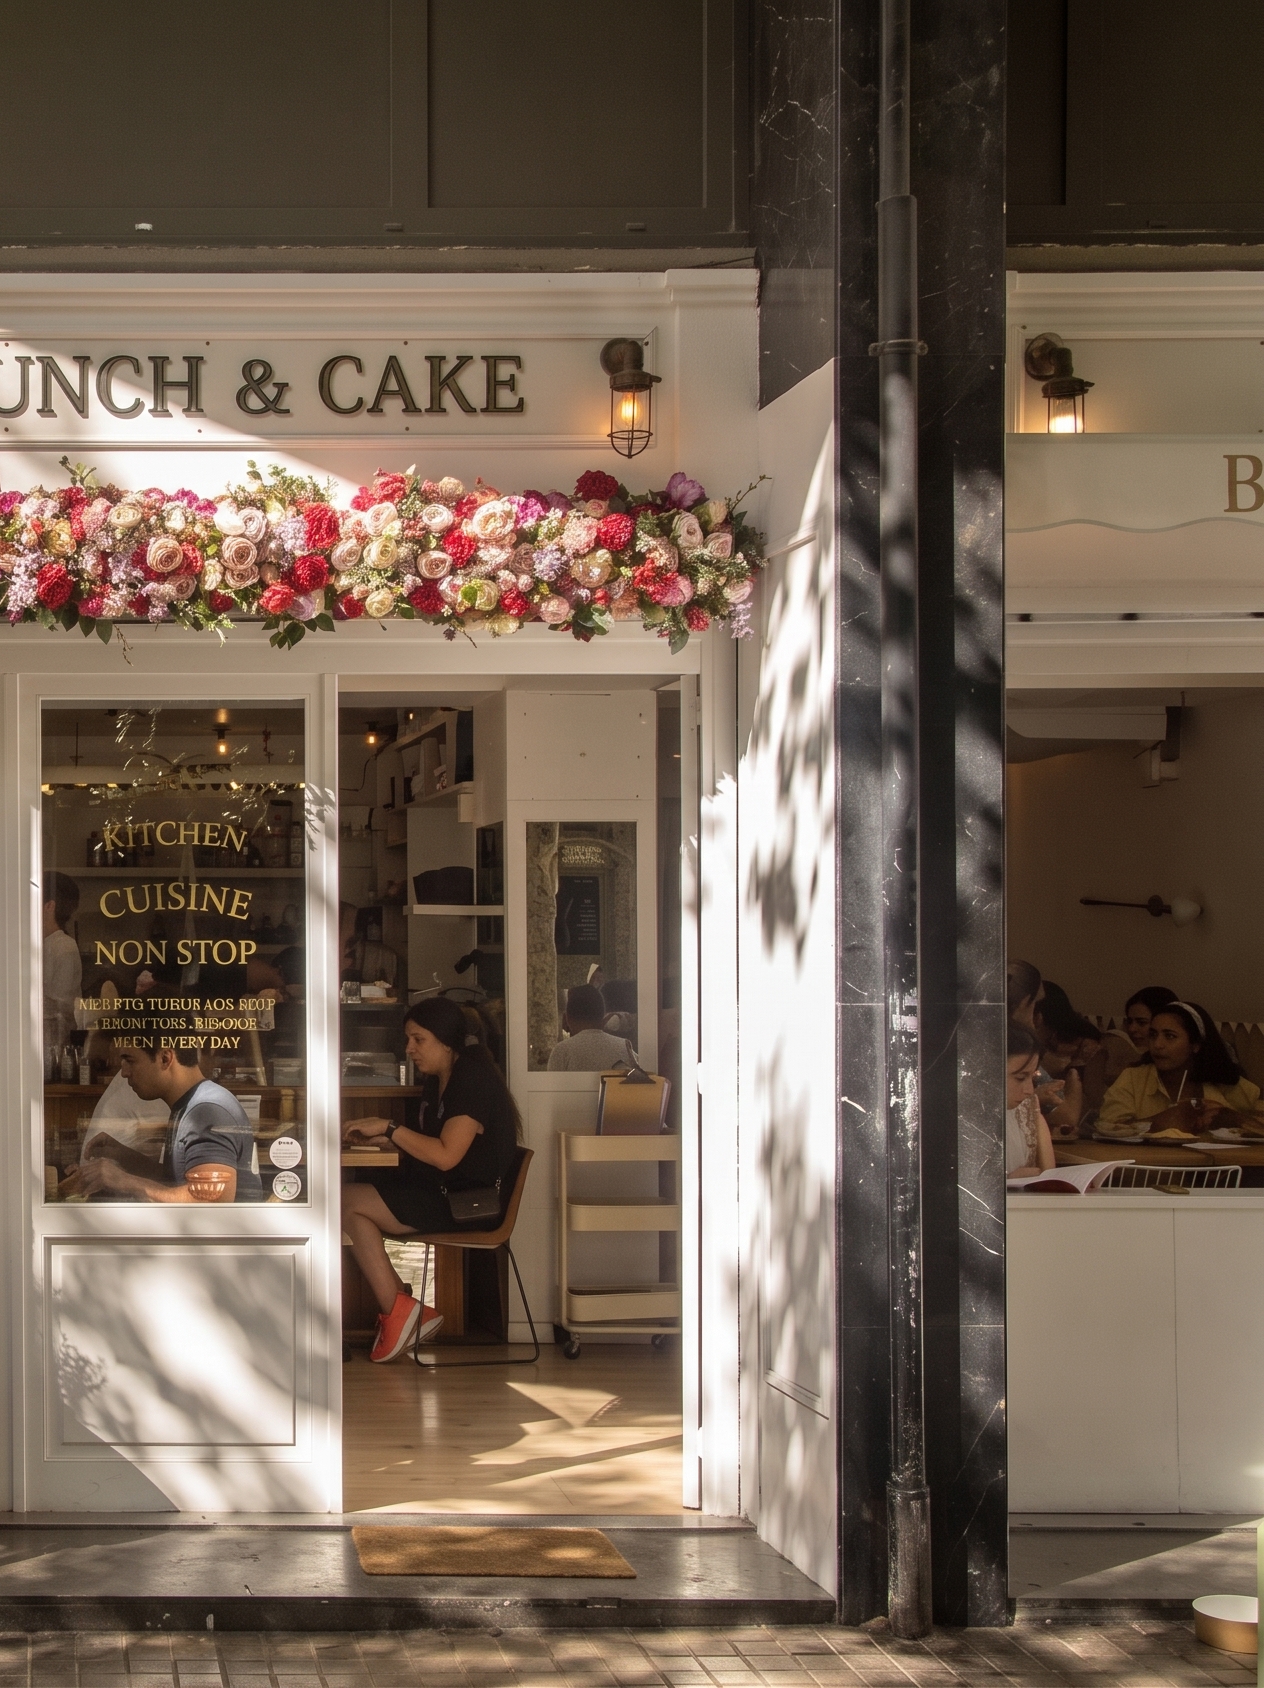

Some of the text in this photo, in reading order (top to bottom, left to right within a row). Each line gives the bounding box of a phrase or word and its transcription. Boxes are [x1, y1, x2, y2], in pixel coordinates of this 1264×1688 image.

[235, 358, 291, 415] &
[318, 355, 525, 415] CAKE
[1222, 454, 1264, 513] B
[102, 820, 248, 852] KITCHEN
[99, 881, 253, 920] CUISINE
[94, 939, 257, 966] NON STOP
[209, 1036, 241, 1049] DAY
